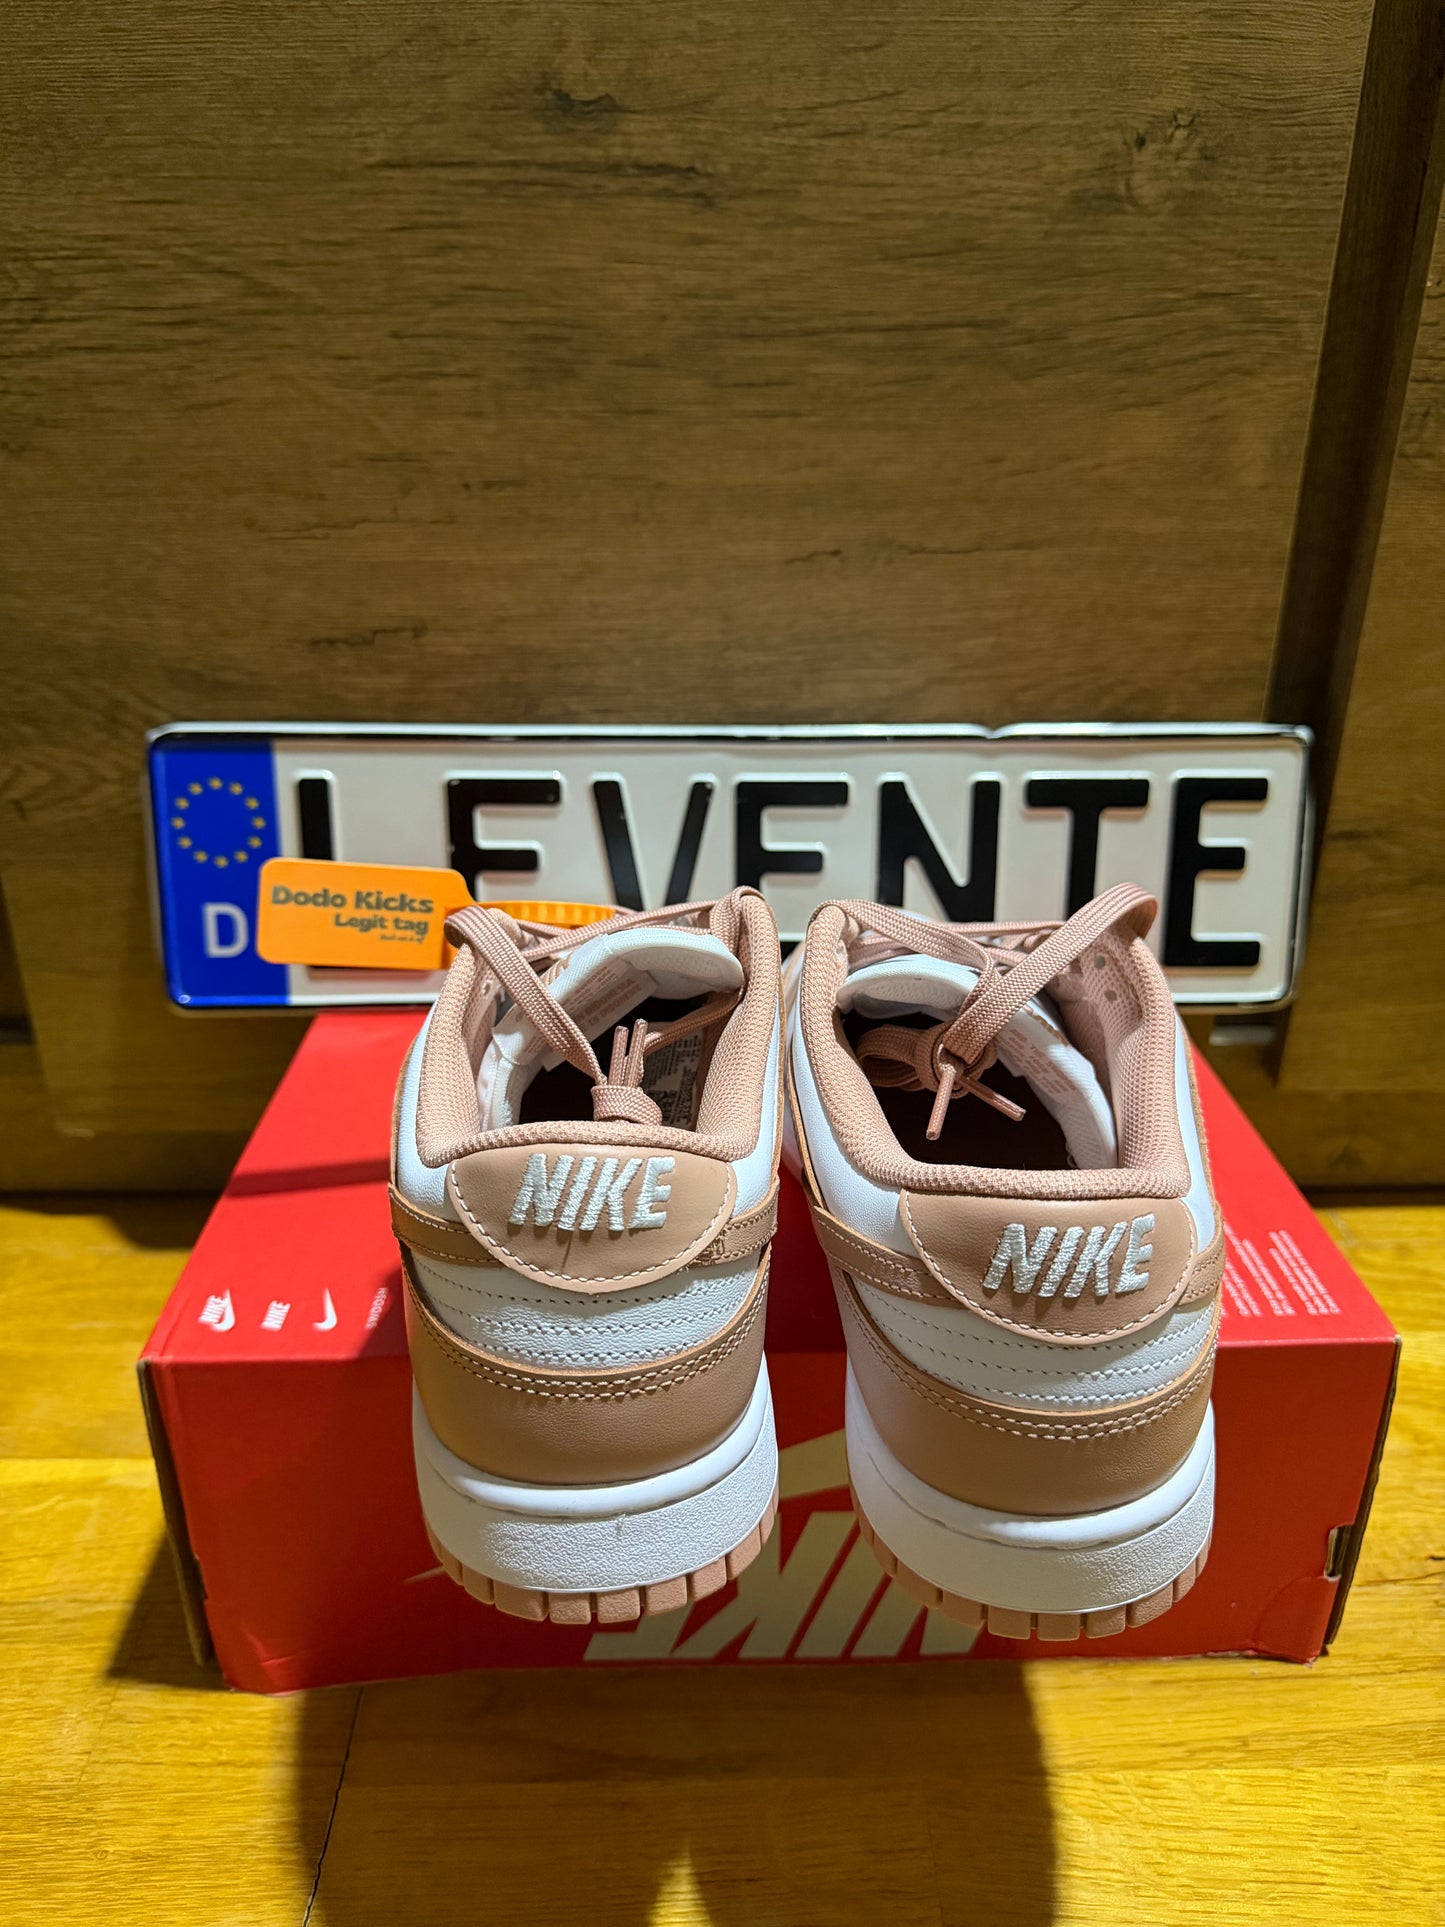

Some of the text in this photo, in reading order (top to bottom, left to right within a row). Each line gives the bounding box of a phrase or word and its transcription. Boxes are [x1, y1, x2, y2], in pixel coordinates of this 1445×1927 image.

[271, 885, 434, 914] Dodo Kicks
[203, 902, 249, 958] D
[333, 913, 429, 936] Legit tag
[509, 1152, 676, 1232] NIKE
[982, 1212, 1157, 1299] NIKE
[260, 1299, 292, 1332] NIKE
